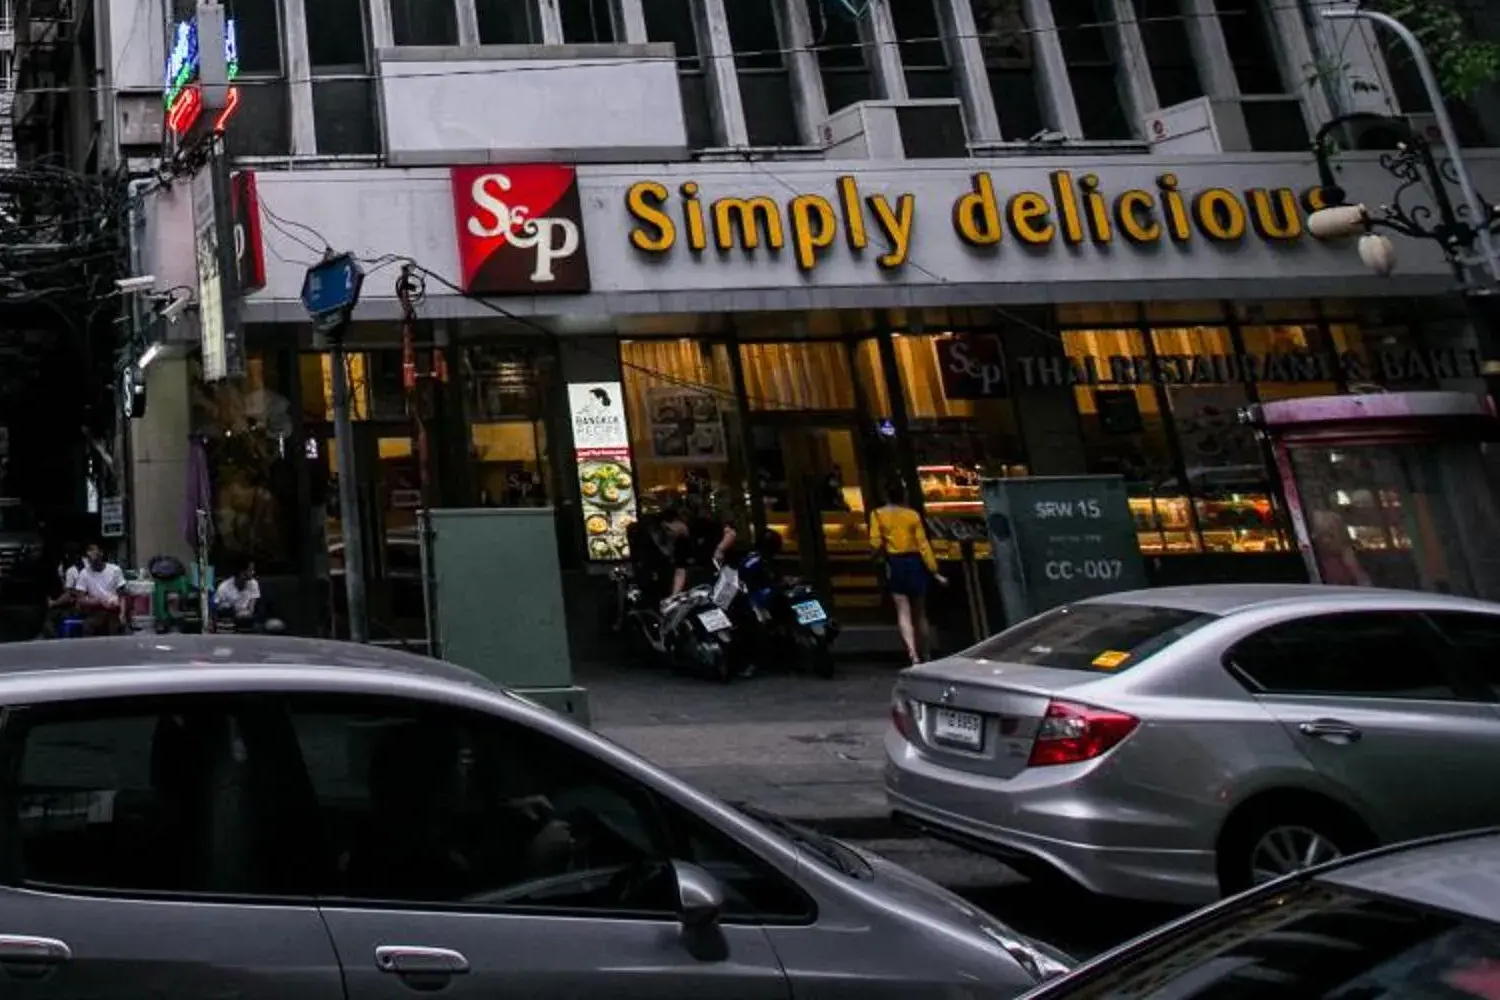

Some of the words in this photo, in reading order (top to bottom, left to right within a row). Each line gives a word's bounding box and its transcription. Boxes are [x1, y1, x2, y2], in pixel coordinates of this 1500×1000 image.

[467, 173, 579, 283] S&P
[626, 176, 915, 269] Simply
[1045, 559, 1123, 580] CC-007
